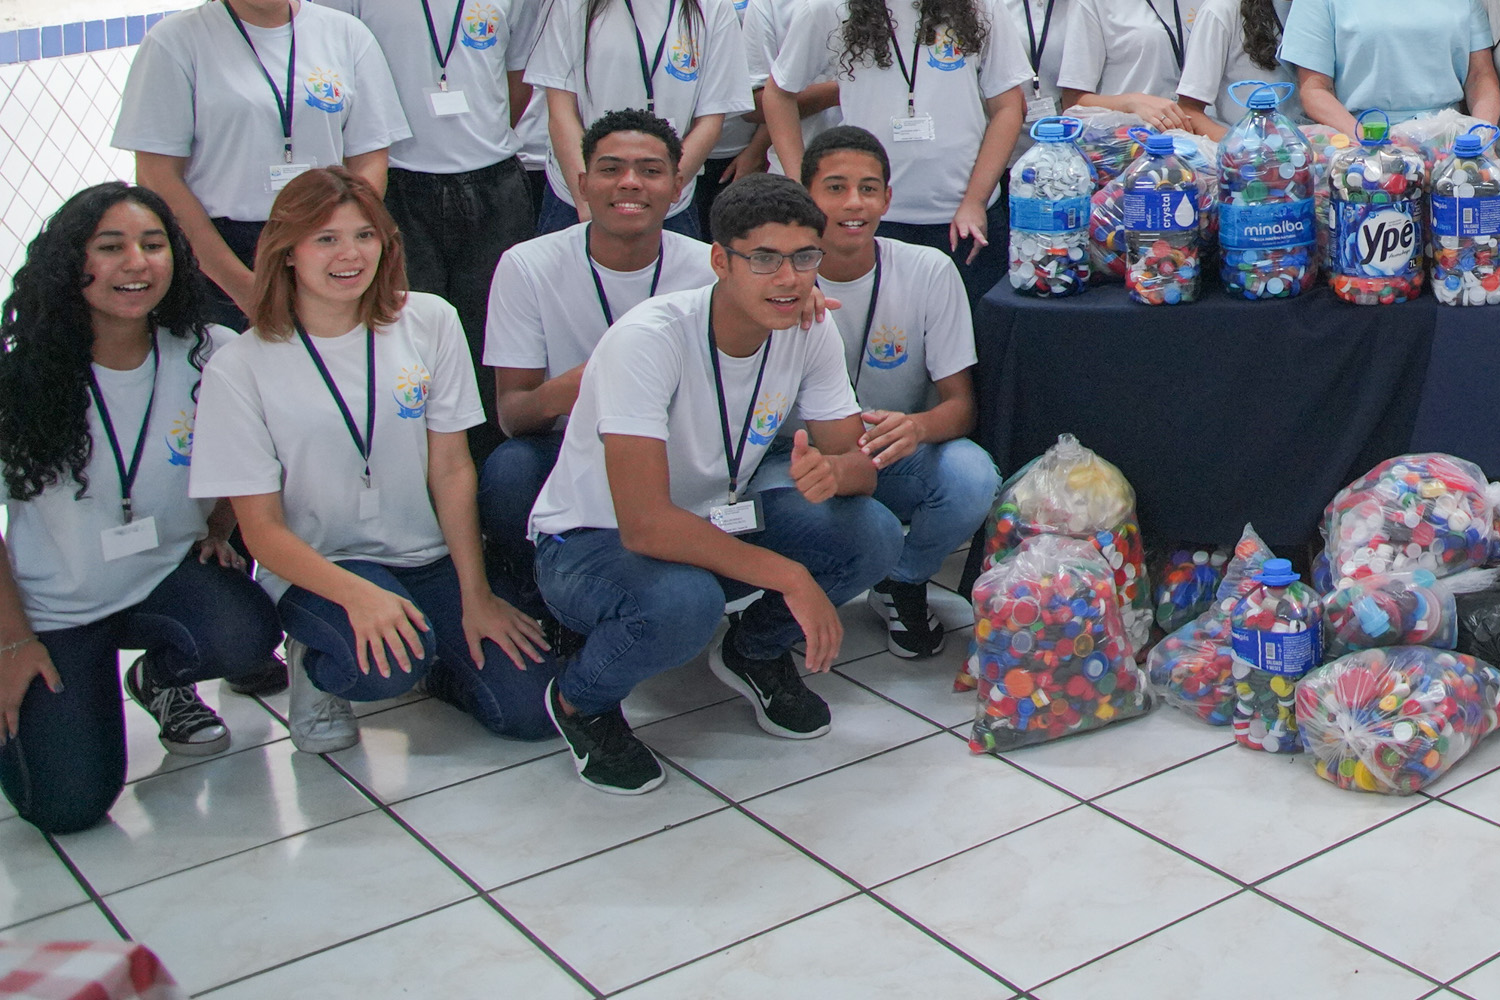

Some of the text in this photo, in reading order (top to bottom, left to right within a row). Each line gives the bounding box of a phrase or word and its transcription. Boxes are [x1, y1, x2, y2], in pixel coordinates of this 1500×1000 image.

[1161, 193, 1173, 228] crystal
[1244, 220, 1304, 236] minalba
[1360, 219, 1414, 265] Ypê
